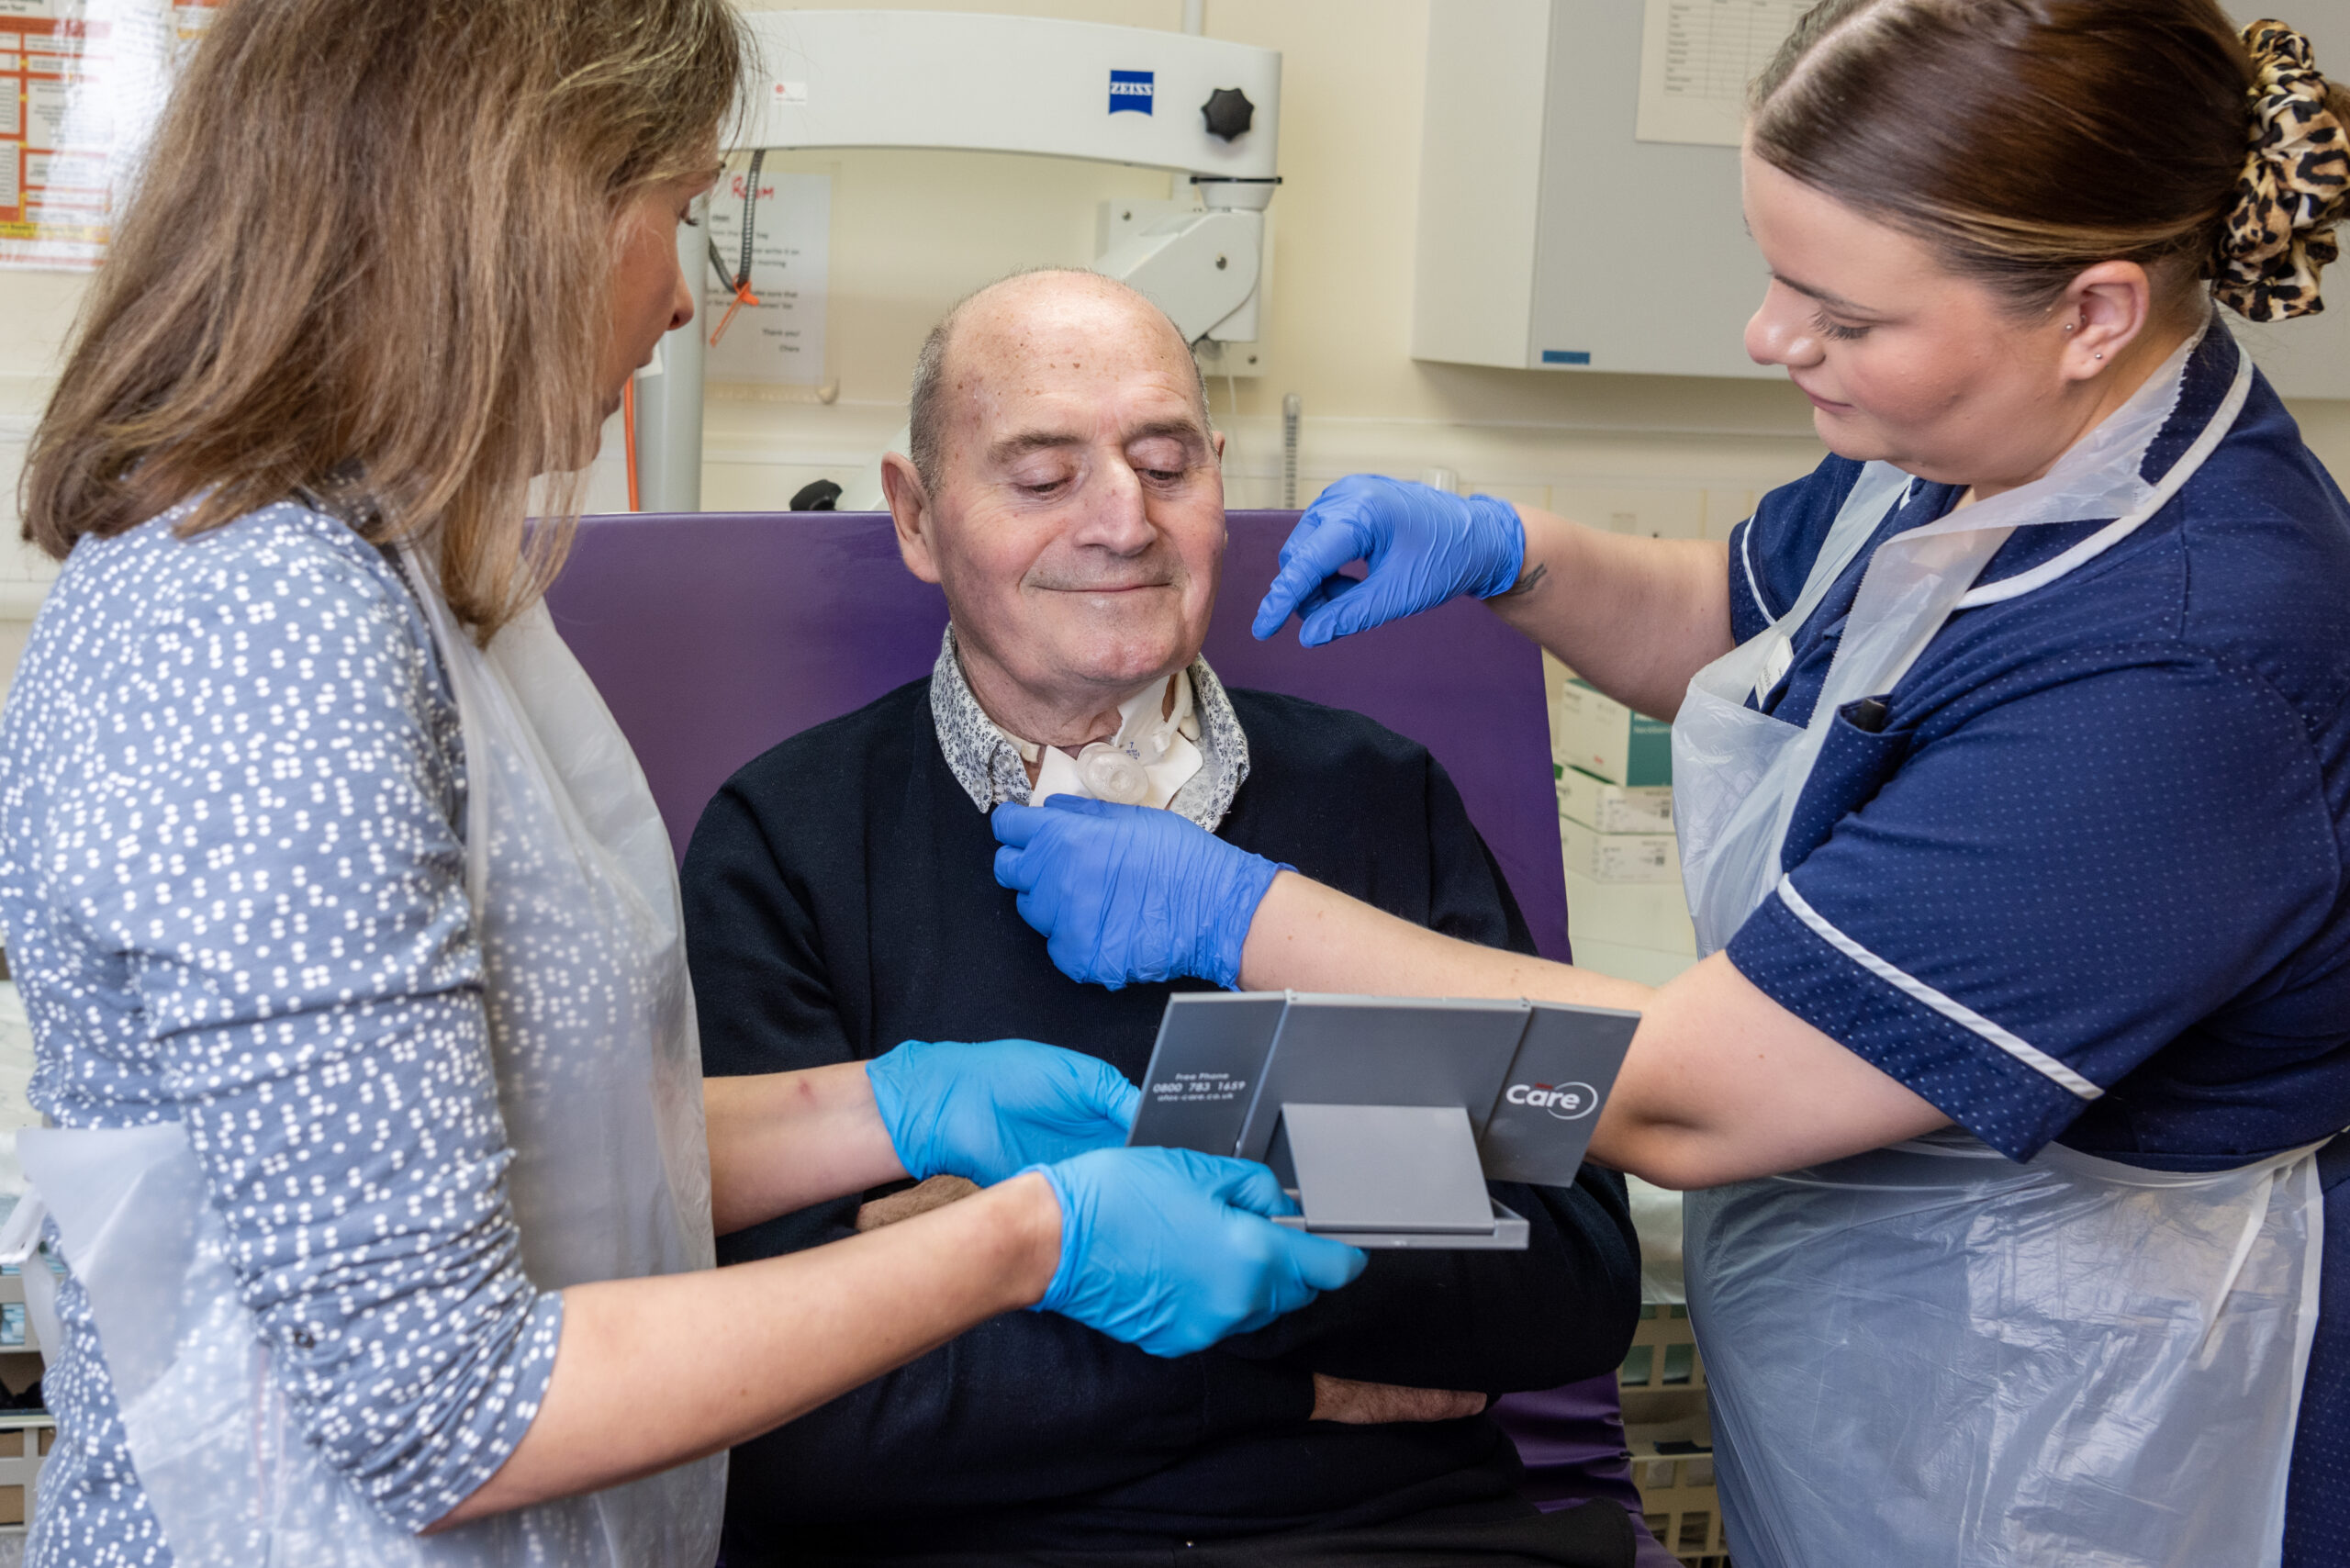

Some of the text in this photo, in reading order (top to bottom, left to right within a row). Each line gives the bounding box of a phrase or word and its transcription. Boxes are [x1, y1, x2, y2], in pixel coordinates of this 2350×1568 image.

[1110, 82, 1153, 96] ZEISS
[1153, 1081, 1246, 1093] 0800 783 1659
[1506, 1084, 1581, 1110] Care
